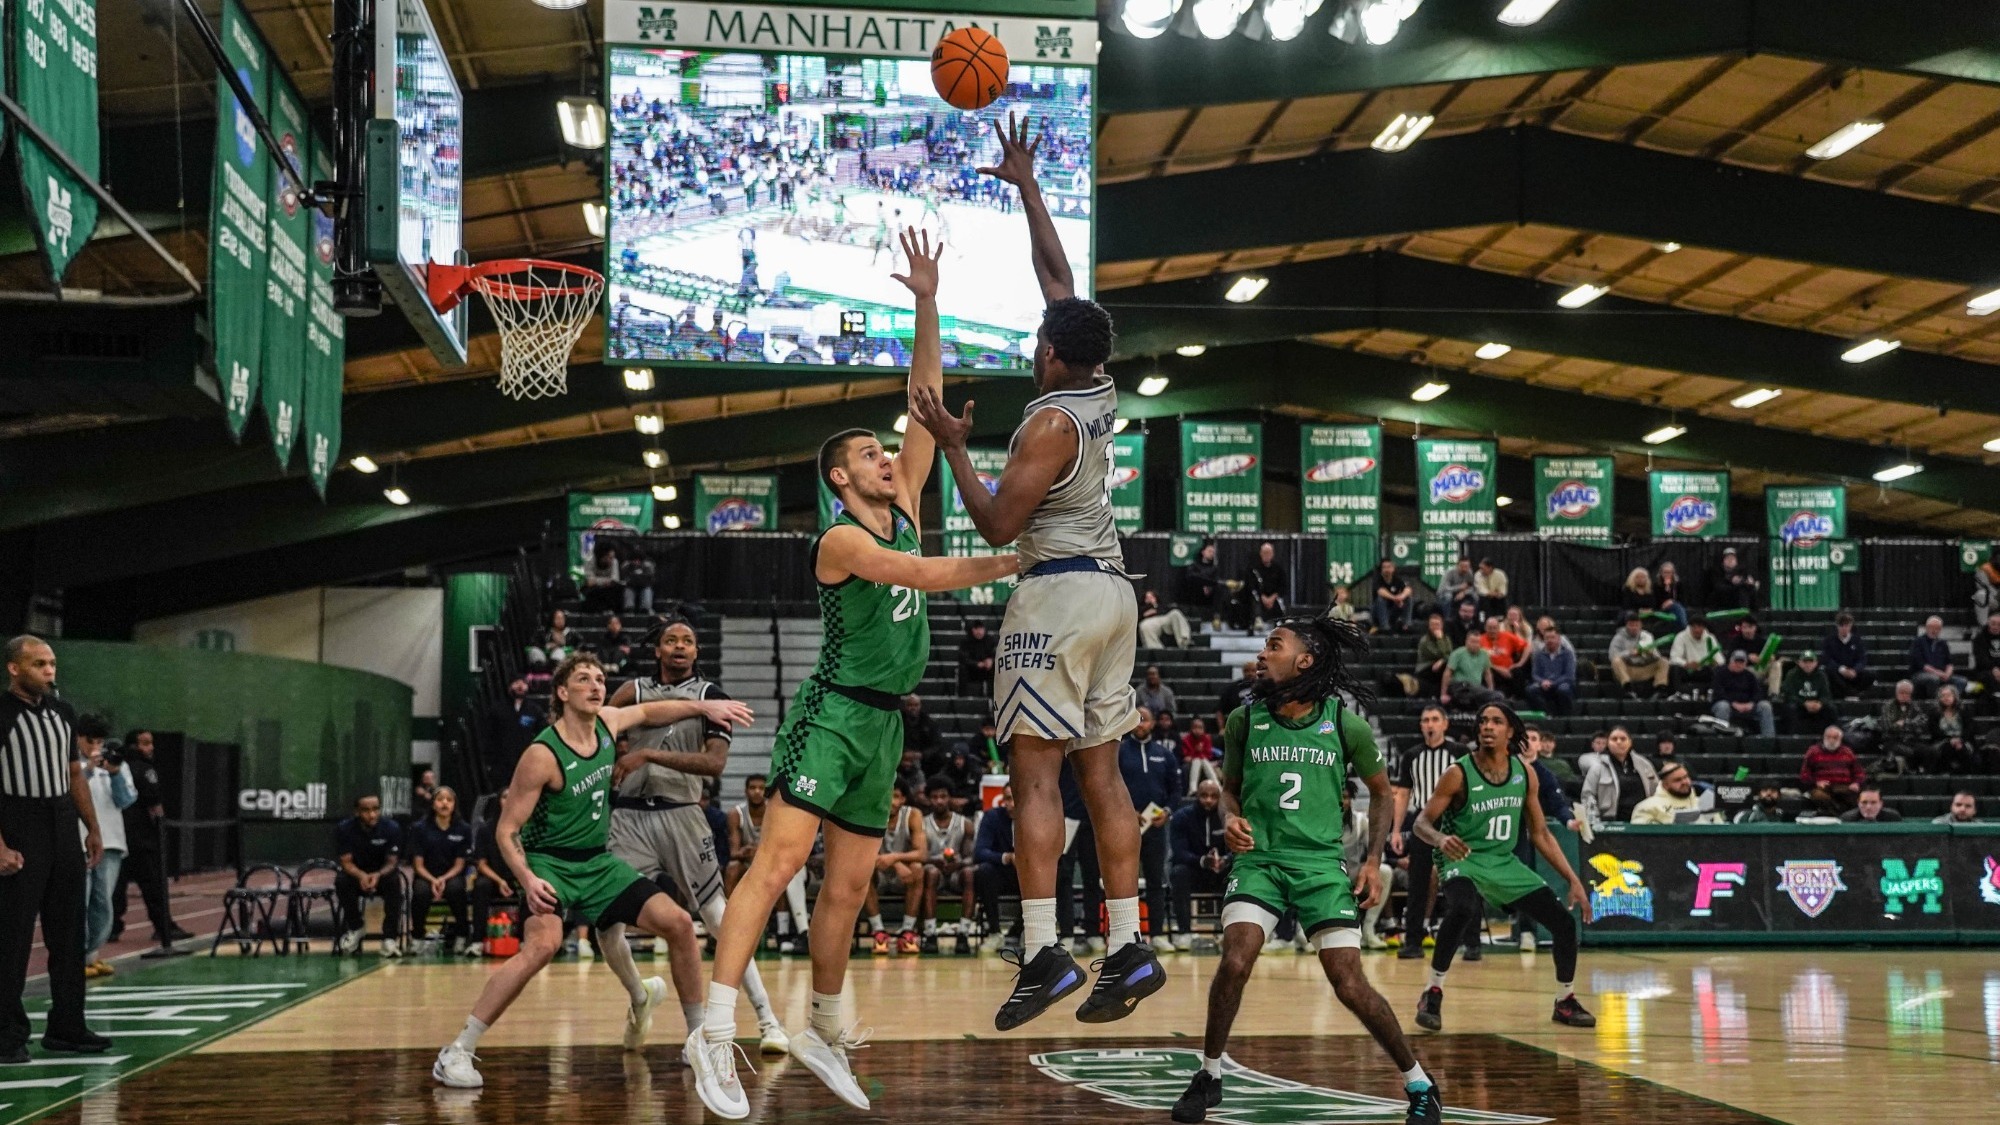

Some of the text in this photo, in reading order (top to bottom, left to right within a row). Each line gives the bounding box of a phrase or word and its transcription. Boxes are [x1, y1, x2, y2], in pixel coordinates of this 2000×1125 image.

[1431, 470, 1484, 500] MAAC
[1186, 492, 1259, 507] CHAMPIONS
[1305, 495, 1377, 510] CHAMPIONS
[1548, 487, 1600, 517] MAAC
[1423, 510, 1494, 524] CHAMPIONS
[1663, 502, 1716, 533] MAAC
[1004, 632, 1053, 652] SAINT
[997, 652, 1057, 674] PETER'S
[1251, 746, 1336, 767] MANHATTAN
[239, 783, 328, 819] capelli
[1279, 772, 1302, 810] 2
[592, 790, 605, 820] 3
[1472, 796, 1523, 813] MANHATTAN
[1485, 815, 1511, 840] 10
[1886, 877, 1940, 896] JASPERS
